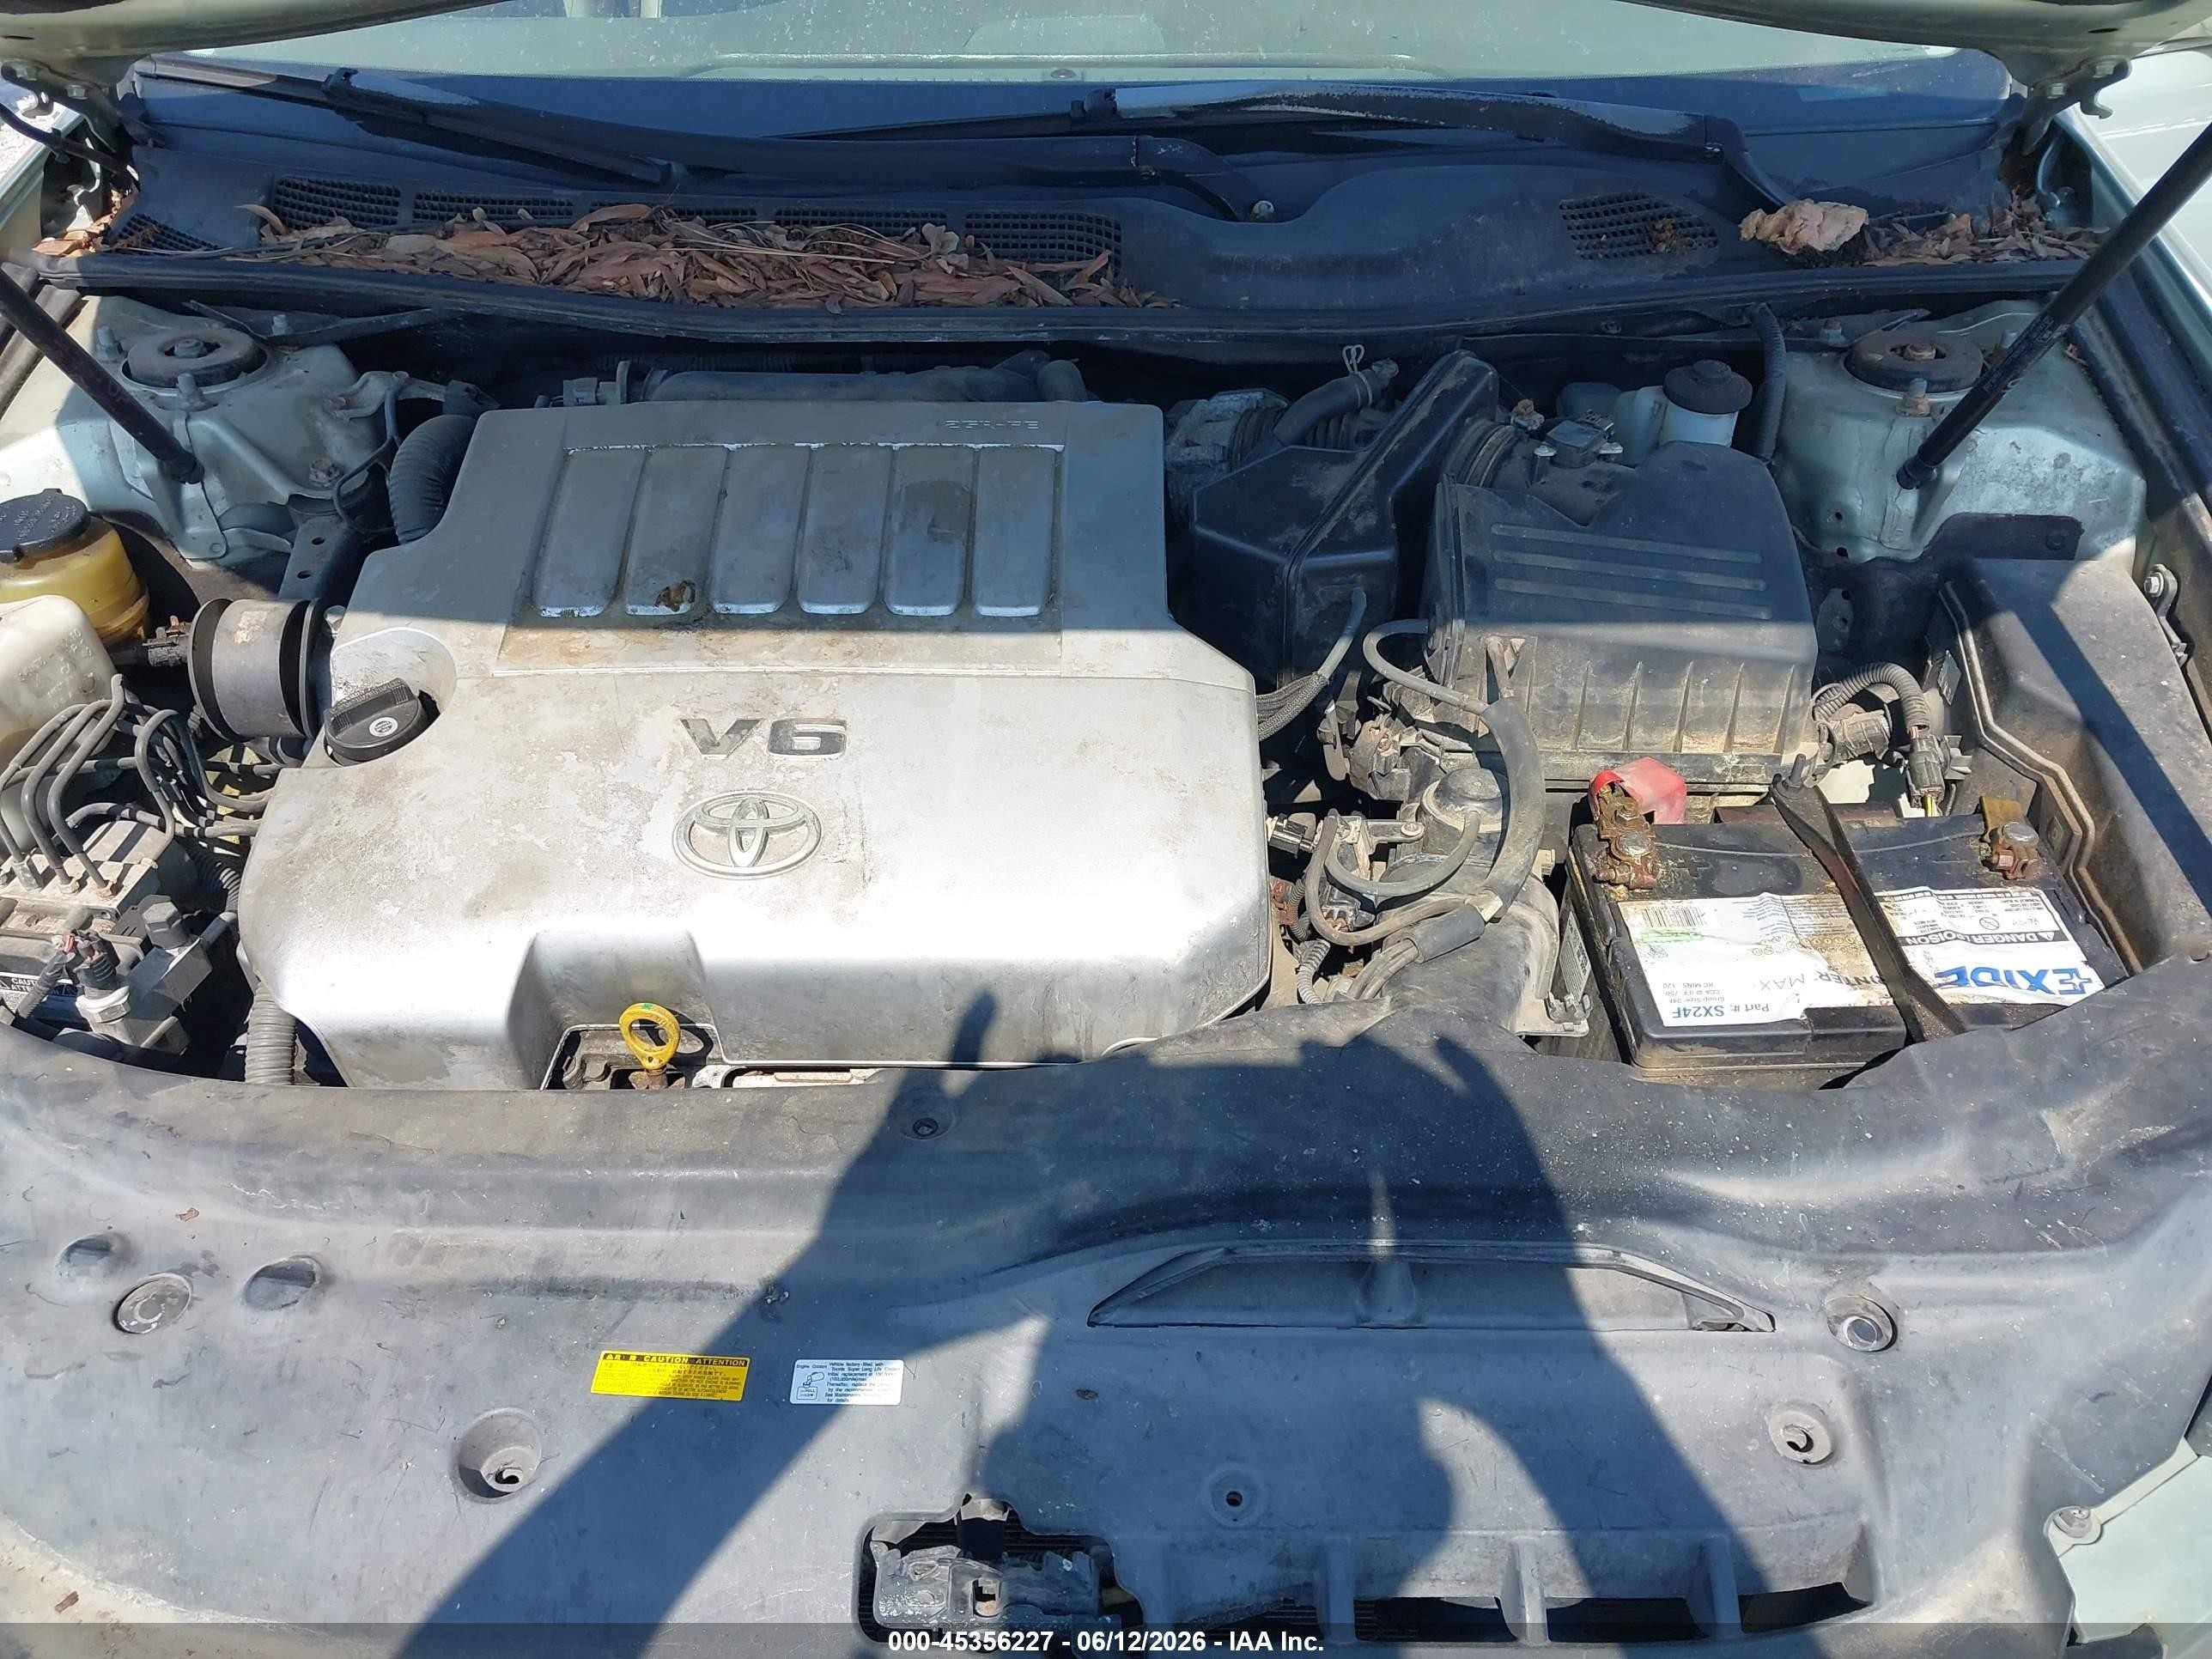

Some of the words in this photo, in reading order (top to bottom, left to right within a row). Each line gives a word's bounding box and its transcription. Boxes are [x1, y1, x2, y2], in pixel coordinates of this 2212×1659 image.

[678, 718, 848, 762] V6
[11, 977, 37, 986] CAUT
[1758, 974, 1805, 992] MAX
[1933, 965, 2093, 994] EXIDE
[1672, 1005, 1725, 1018] SX24F
[1746, 1003, 1770, 1012] Part
[643, 1354, 689, 1364] CAUTION
[696, 1358, 745, 1366] ATTENTION
